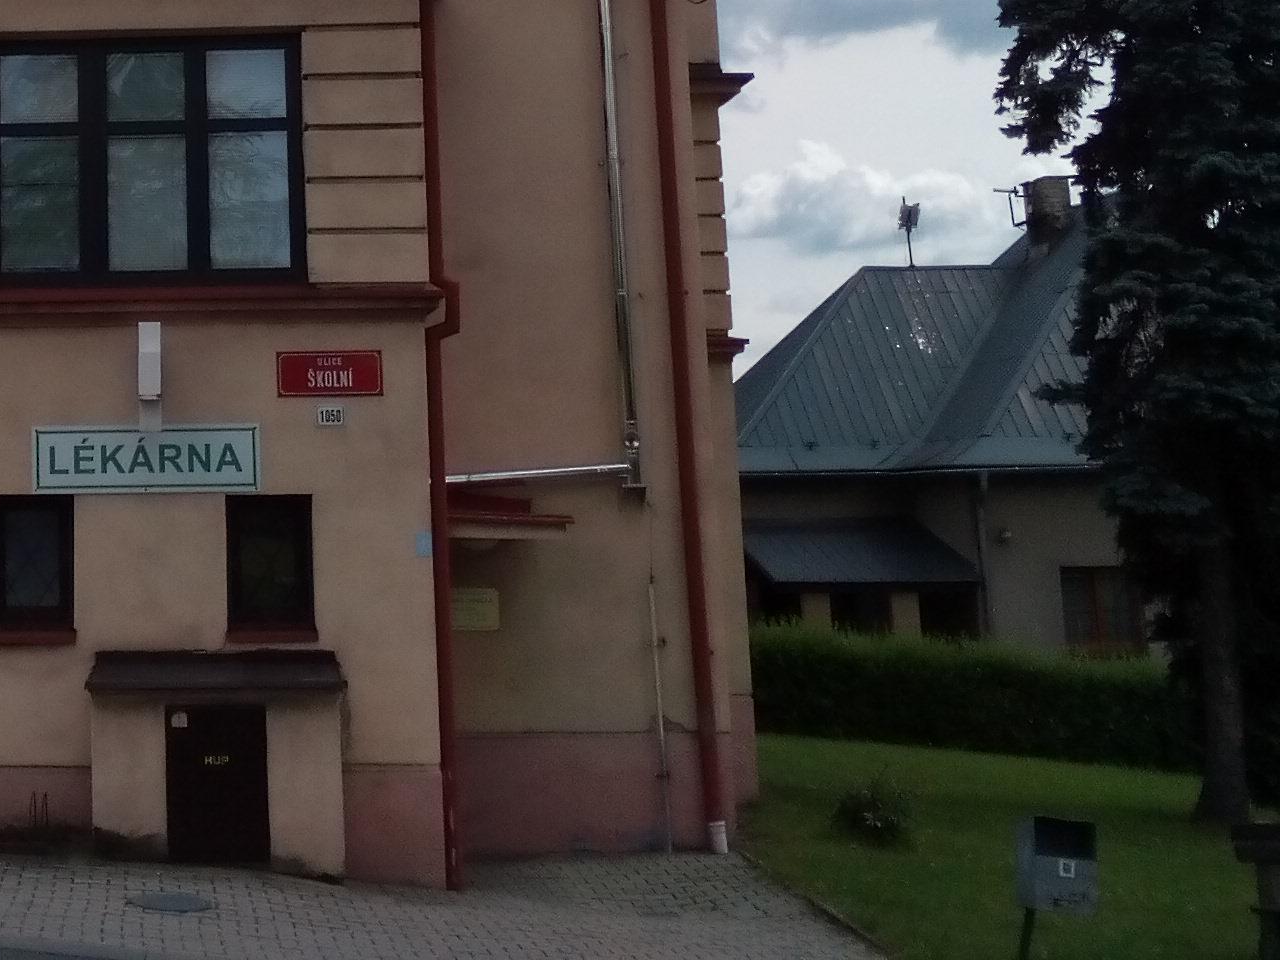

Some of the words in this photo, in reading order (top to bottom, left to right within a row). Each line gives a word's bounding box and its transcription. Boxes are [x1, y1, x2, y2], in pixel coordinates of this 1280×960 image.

[317, 356, 343, 366] ULICE
[307, 367, 353, 388] ŠKOLNÍ
[48, 437, 244, 475] LÉKÁRNA
